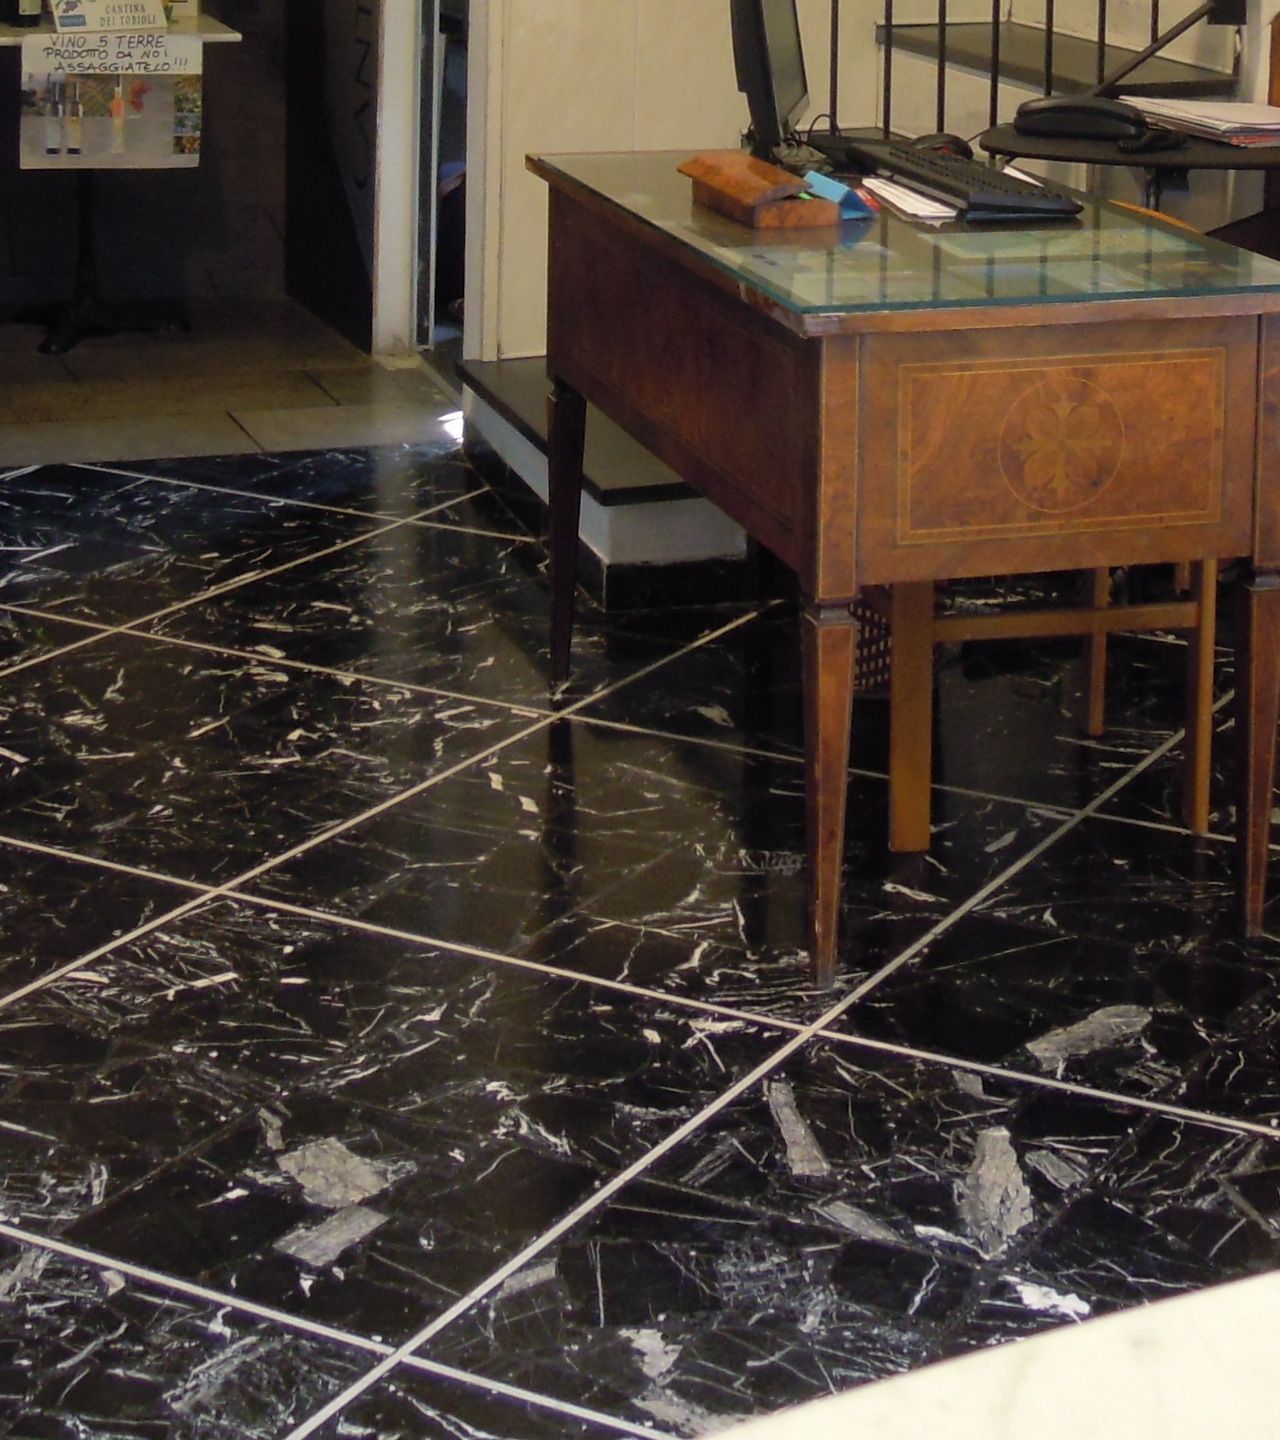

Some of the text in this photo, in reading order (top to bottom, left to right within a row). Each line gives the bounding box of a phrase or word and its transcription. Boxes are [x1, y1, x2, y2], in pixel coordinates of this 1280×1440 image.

[105, 3, 146, 15] CANTINA
[100, 17, 116, 27] DEI
[98, 35, 108, 48] 5
[115, 34, 165, 49] TERRE
[43, 47, 108, 60] PRODOTTO
[116, 49, 133, 59] DA
